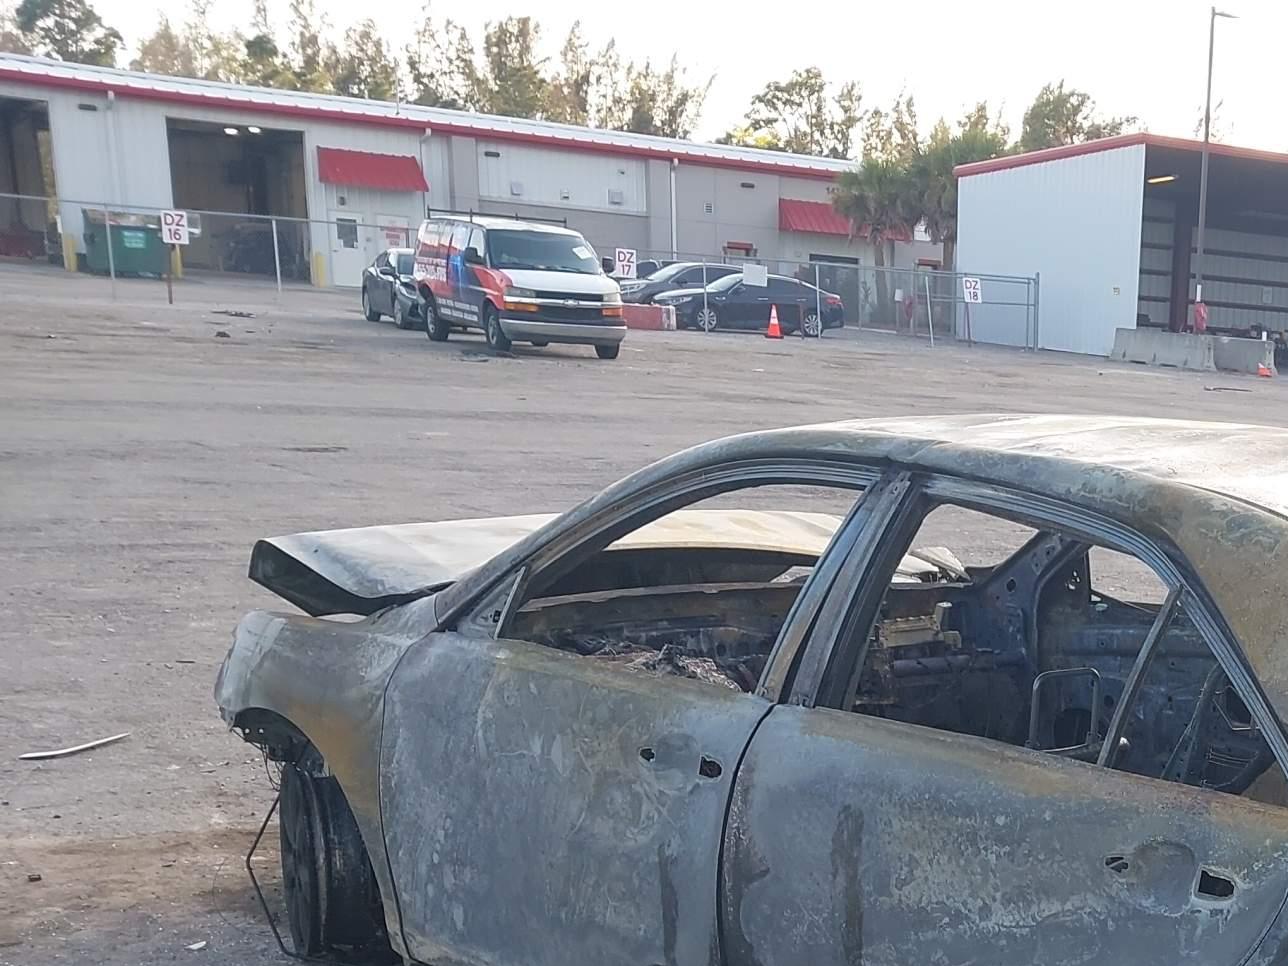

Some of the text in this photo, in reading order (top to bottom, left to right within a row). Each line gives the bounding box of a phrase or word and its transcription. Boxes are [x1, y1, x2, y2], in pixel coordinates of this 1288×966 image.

[164, 213, 185, 227] DZ
[168, 228, 182, 241] 16
[617, 250, 635, 264] DZ
[621, 263, 632, 276] 17
[964, 279, 980, 290] DZ
[968, 290, 979, 301] 18
